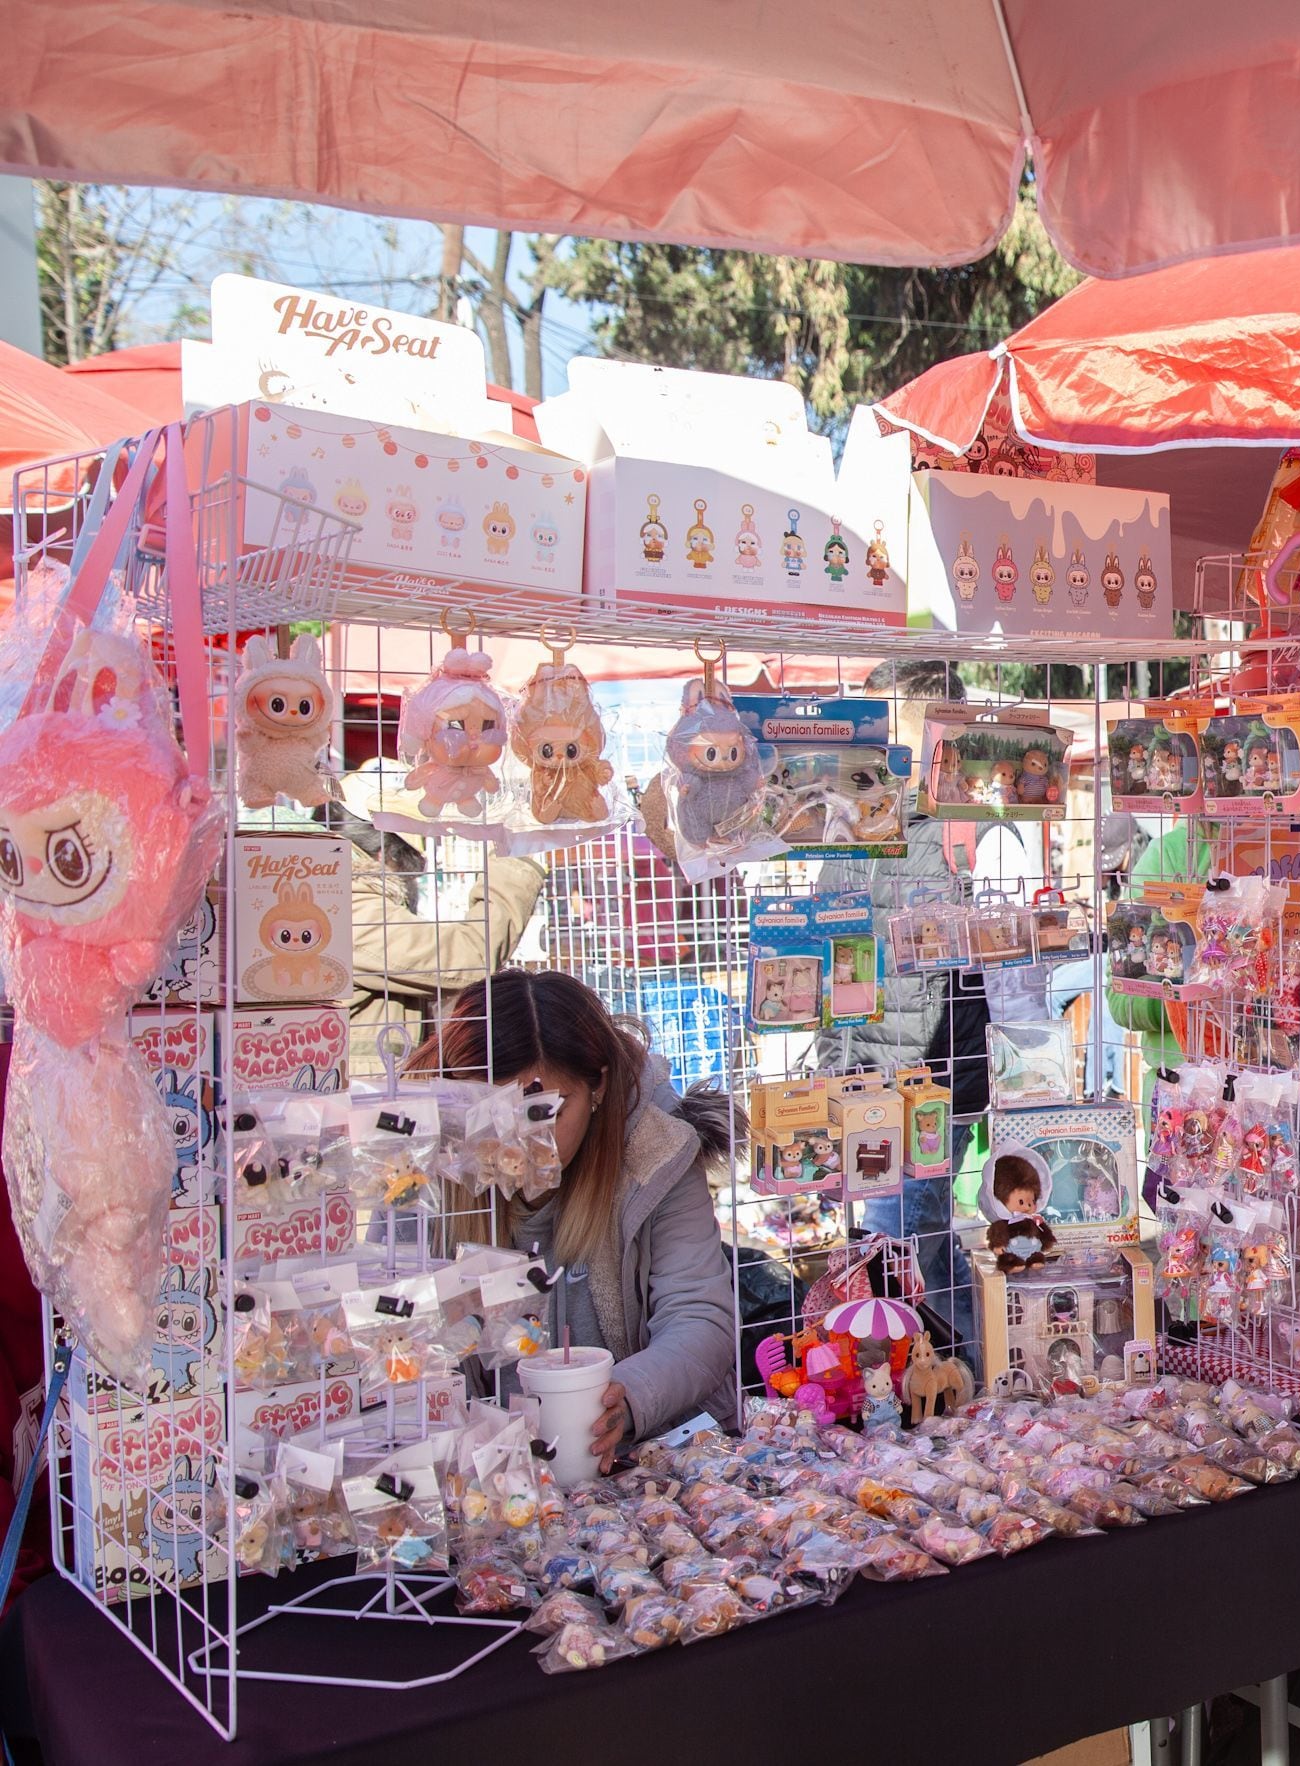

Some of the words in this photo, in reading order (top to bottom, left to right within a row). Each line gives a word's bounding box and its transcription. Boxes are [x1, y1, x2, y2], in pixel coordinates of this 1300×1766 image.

[273, 295, 368, 334] Have
[361, 317, 442, 359] Seat
[724, 606, 767, 616] DESIGNS
[767, 722, 811, 738] Sylvanian
[248, 855, 299, 879] Have
[295, 857, 340, 879] Seat
[758, 917, 783, 925] Sylvanian
[818, 913, 845, 921] Sylvanian
[241, 1018, 341, 1058] EXCITING
[233, 1048, 329, 1078] MACARON
[1038, 1127, 1068, 1136] Sylvanian
[251, 1203, 347, 1248] EXCITING
[1107, 1233, 1134, 1242] TOMY
[127, 1507, 143, 1517] ace
